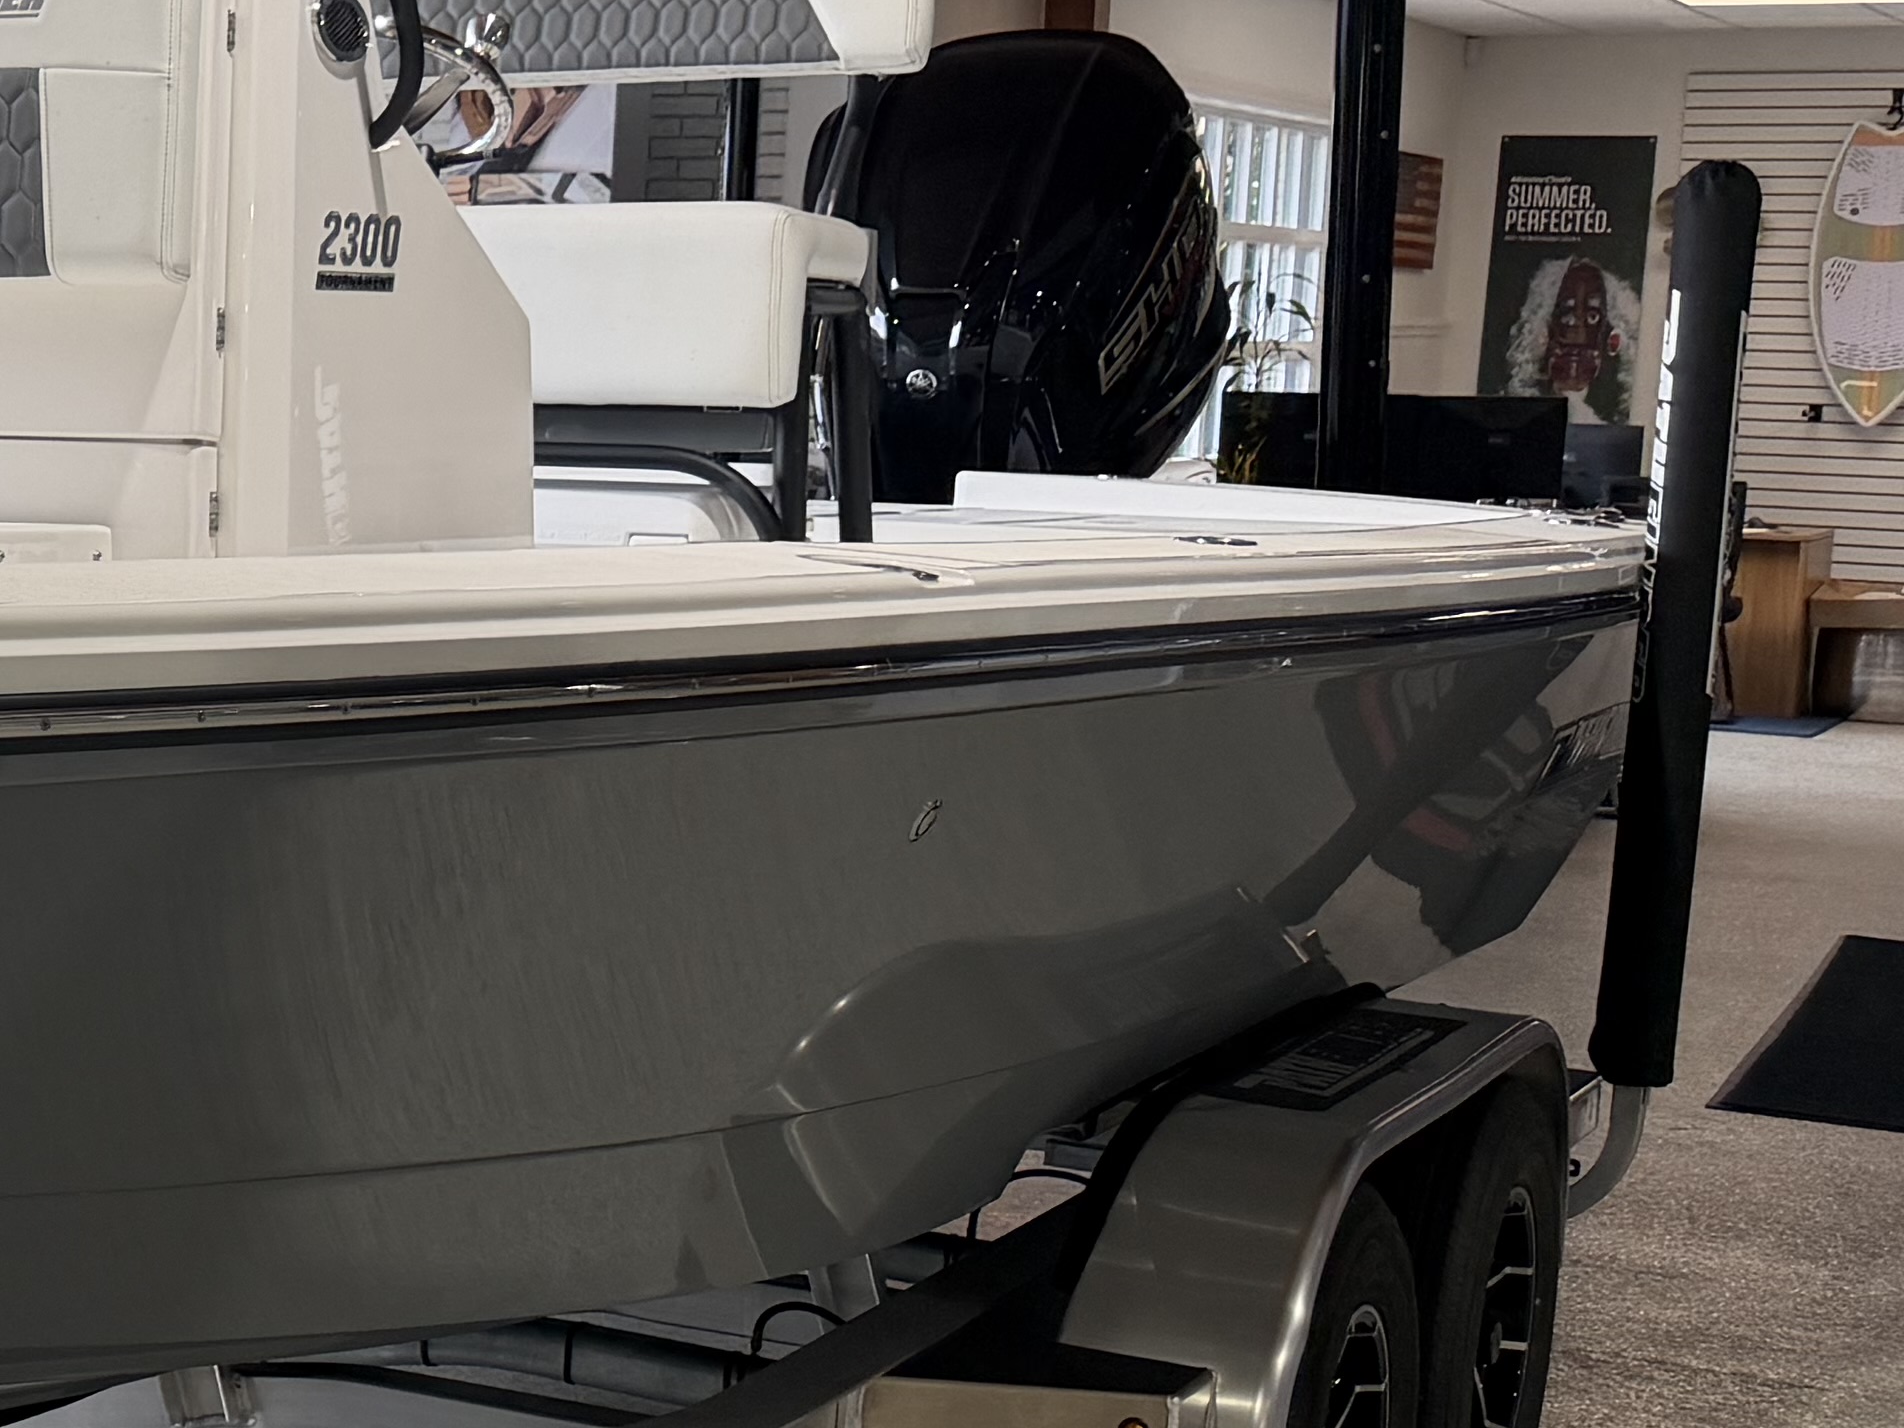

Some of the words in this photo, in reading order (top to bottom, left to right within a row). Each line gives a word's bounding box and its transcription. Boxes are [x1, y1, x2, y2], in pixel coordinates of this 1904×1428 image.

[1507, 184, 1596, 209] SUMMER,
[1505, 209, 1612, 233] PERFECTED.
[318, 211, 401, 268] 2300
